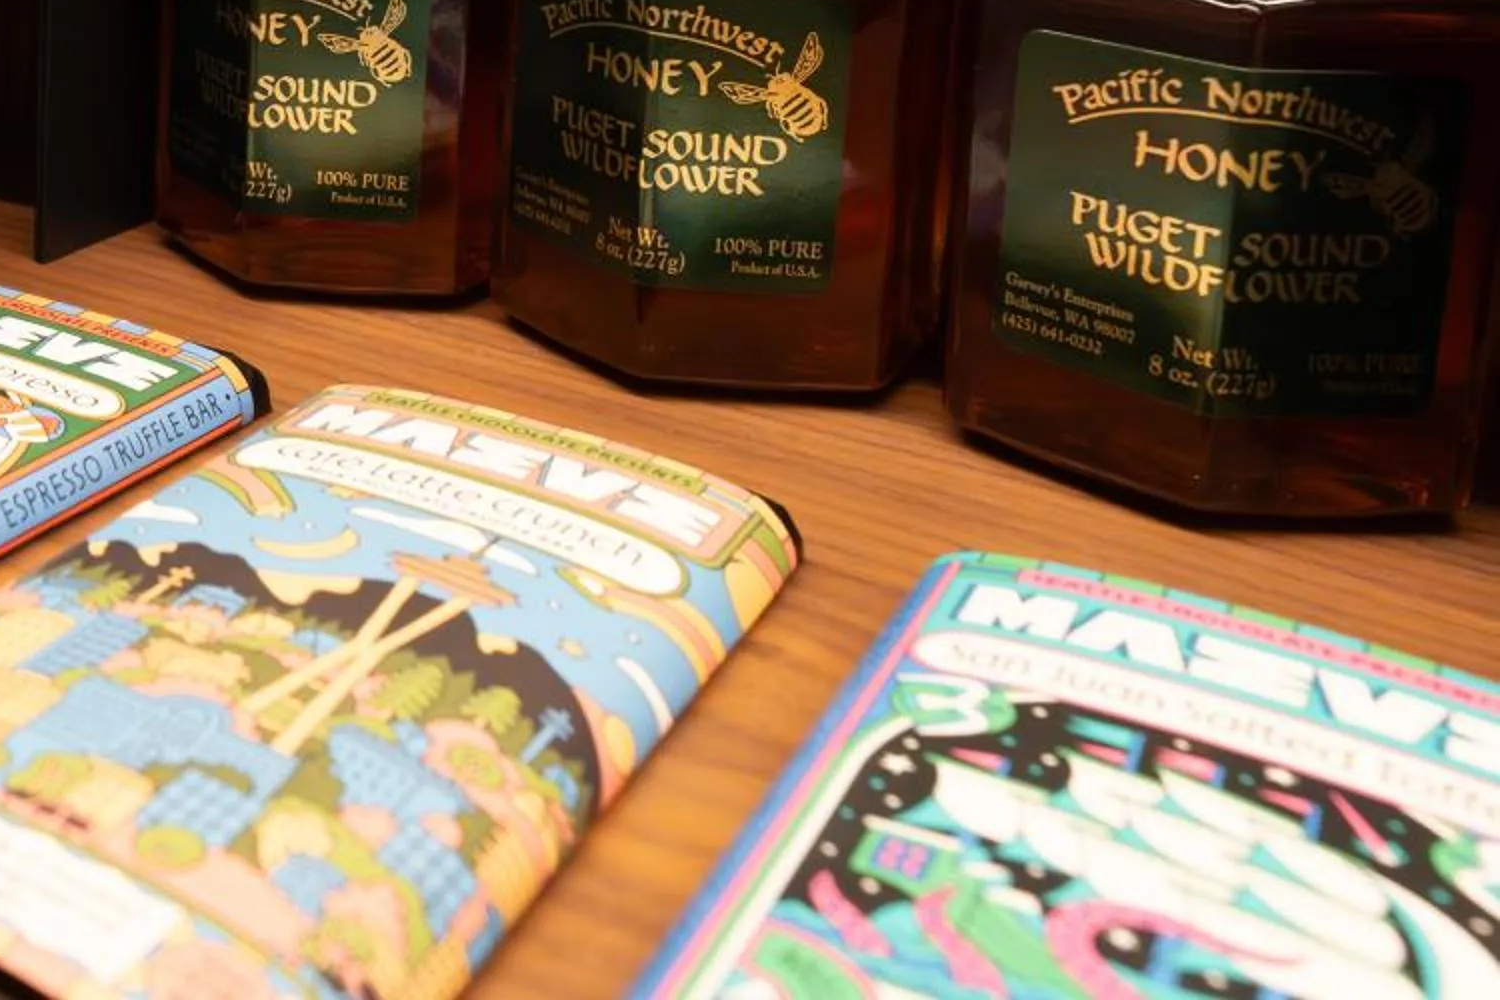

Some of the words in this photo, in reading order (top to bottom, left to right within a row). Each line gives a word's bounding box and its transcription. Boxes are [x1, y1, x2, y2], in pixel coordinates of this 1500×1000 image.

[587, 42, 722, 96] HONEY
[254, 75, 377, 108] SOUND
[1053, 67, 1183, 116] Pacific
[1202, 76, 1397, 149] Northwest
[552, 96, 636, 147] PUGET
[642, 129, 788, 165] SOUND
[316, 170, 357, 188] 100%
[362, 172, 410, 192] PURE
[560, 130, 764, 197] WILDFLOWER
[1134, 130, 1326, 192] HONEY
[246, 181, 293, 204] 227g)
[609, 216, 632, 239] Net
[637, 226, 669, 250] Wt.
[715, 236, 764, 255] 100%
[768, 238, 824, 260] PURE
[1070, 191, 1221, 260] PUGET
[1234, 231, 1390, 270] SOUND
[596, 231, 605, 251] 8
[627, 246, 686, 275] (227g)
[731, 260, 771, 275] Product
[772, 262, 783, 275] of
[784, 262, 821, 278] U.S.A.
[1085, 231, 1361, 304] WILDFLOWER
[1005, 270, 1060, 299] Garvey's
[1064, 308, 1089, 331] WA
[1172, 335, 1216, 368] Net
[1148, 353, 1163, 375] 8
[1168, 366, 1199, 387] oz.
[1204, 369, 1277, 399] (227g)
[2, 454, 105, 530] ESPRESSO
[103, 411, 185, 472] TRUFFLE
[184, 392, 224, 429] BAR
